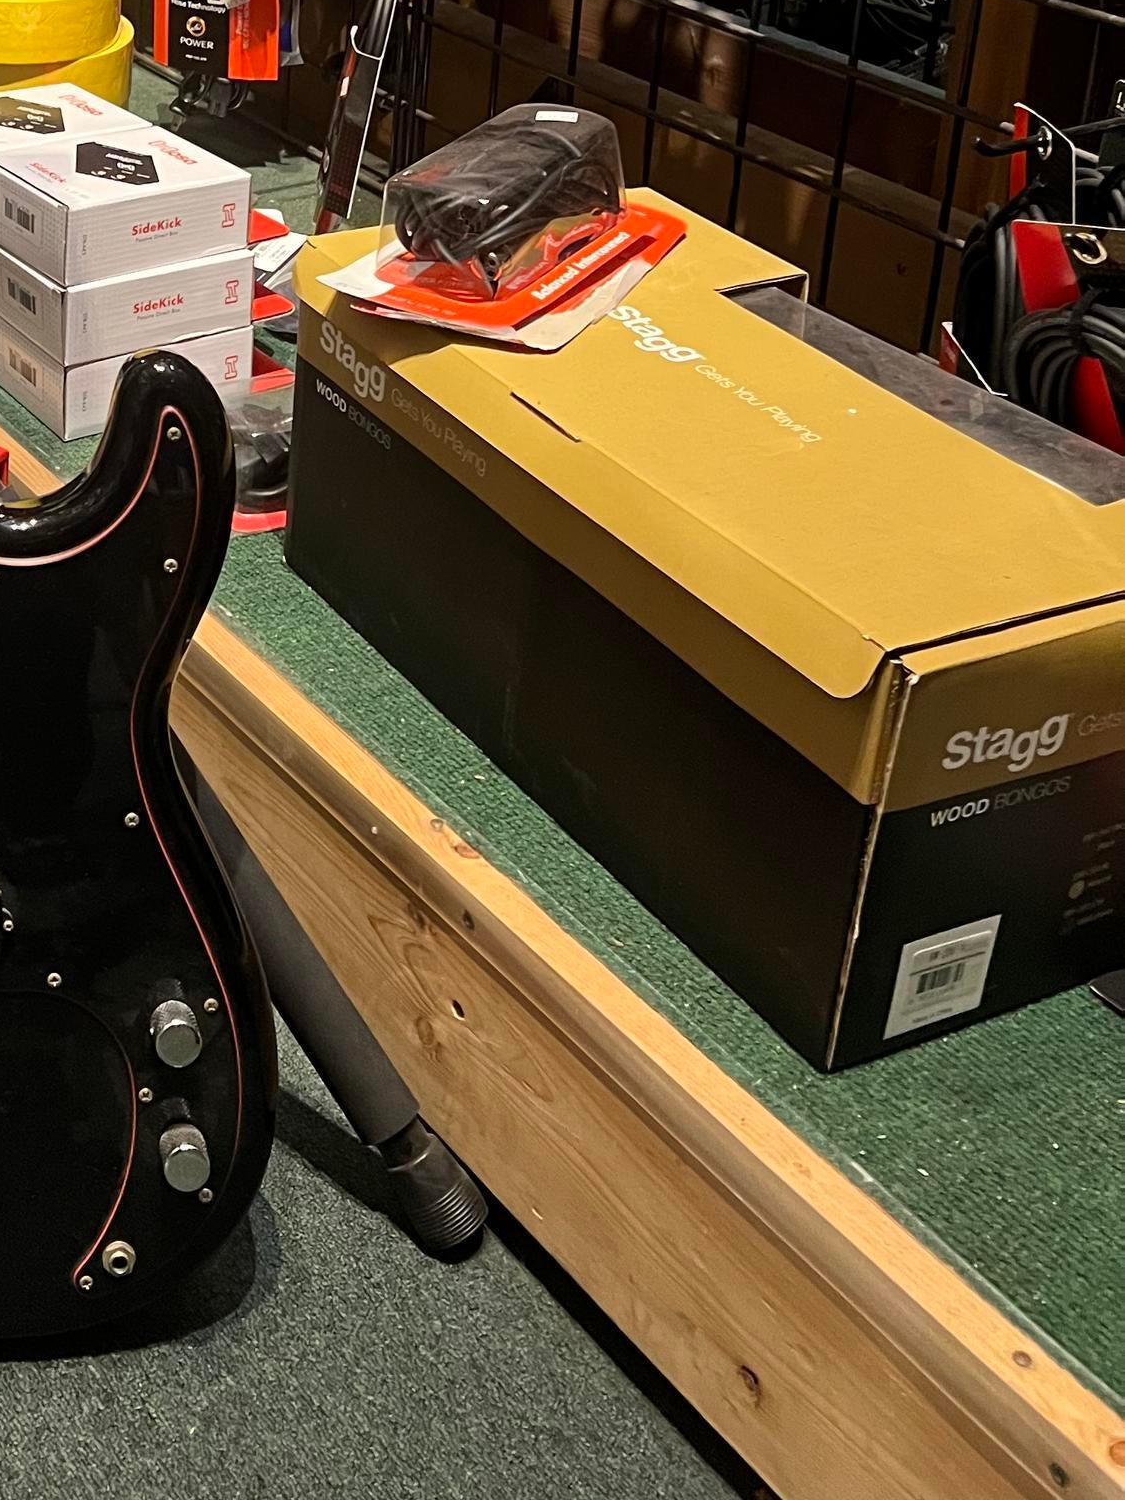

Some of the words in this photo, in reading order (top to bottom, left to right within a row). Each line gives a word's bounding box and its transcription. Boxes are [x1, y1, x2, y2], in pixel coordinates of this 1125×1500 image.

[188, 1, 226, 14] Technology
[180, 36, 214, 50] POWER
[131, 217, 183, 237] SideKick
[530, 264, 580, 301] Balanced
[577, 231, 631, 270] Interconnect
[132, 293, 184, 315] SideKick
[319, 321, 386, 402] Stagg
[607, 304, 707, 363] Stagg
[694, 364, 737, 390] Gets
[732, 386, 765, 407] You
[762, 404, 823, 444] Playing
[316, 379, 347, 413] WOOD
[941, 713, 1071, 772] Stagg
[930, 798, 990, 827] WOOD
[993, 775, 1072, 811] BONGOS
